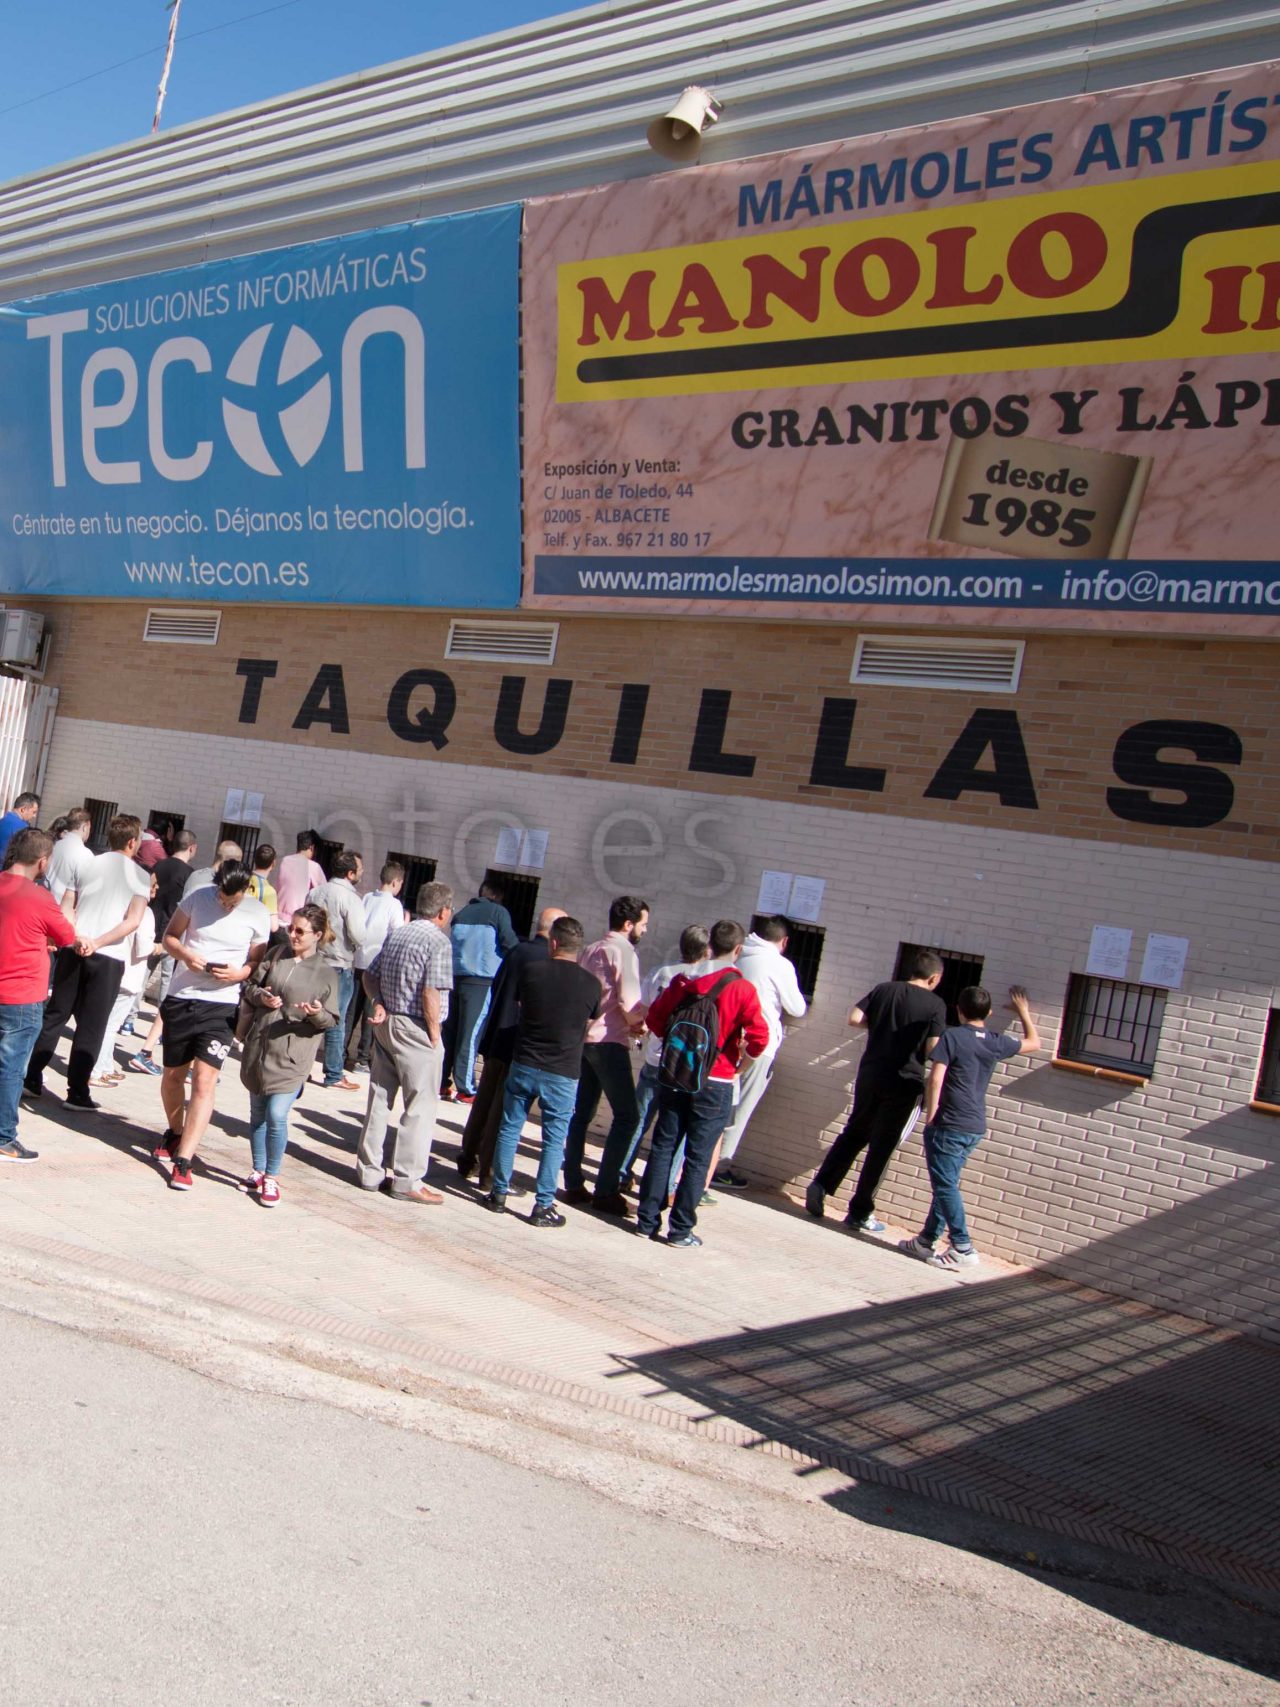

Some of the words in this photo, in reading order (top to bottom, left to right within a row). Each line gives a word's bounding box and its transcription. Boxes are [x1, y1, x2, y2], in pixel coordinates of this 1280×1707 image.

[737, 133, 1053, 227] MÁRMOLES
[1075, 90, 1280, 175] ARTÍS
[96, 284, 229, 335] SOLUCIONES
[237, 248, 427, 311] INFORMÁTICAS
[577, 212, 1108, 346] MANOLO
[731, 394, 1029, 450] GRANITOS
[1050, 390, 1098, 435] Y
[544, 460, 617, 480] Exposición
[621, 462, 631, 478] y
[635, 458, 681, 475] Venta:
[985, 459, 1089, 497] desde
[544, 486, 557, 500] C/
[561, 486, 590, 500] Juan
[595, 484, 613, 499] de
[618, 483, 671, 500] Toledo,
[676, 483, 694, 498] 44
[13, 511, 76, 537] Céntrate
[80, 516, 101, 535] en
[104, 514, 122, 535] tu
[126, 511, 208, 539] negocio.
[216, 506, 303, 538] Déjanos
[308, 505, 328, 533] la
[334, 501, 475, 536] tecnología.
[544, 509, 582, 523] 02005
[594, 508, 670, 523] ALBACETE
[961, 492, 1097, 548] 1985
[544, 533, 569, 547] Telf.
[573, 535, 580, 550] y
[585, 533, 612, 547] Fax.
[617, 533, 642, 547] 967
[647, 533, 664, 547] 21
[670, 533, 688, 547] 80
[694, 533, 711, 547] 17
[124, 555, 310, 586] www.tecon.es
[578, 565, 1023, 600] www.marmolesmanolosimon.com
[235, 657, 1246, 829] TAQUILLAS
[207, 1039, 231, 1060] 36
